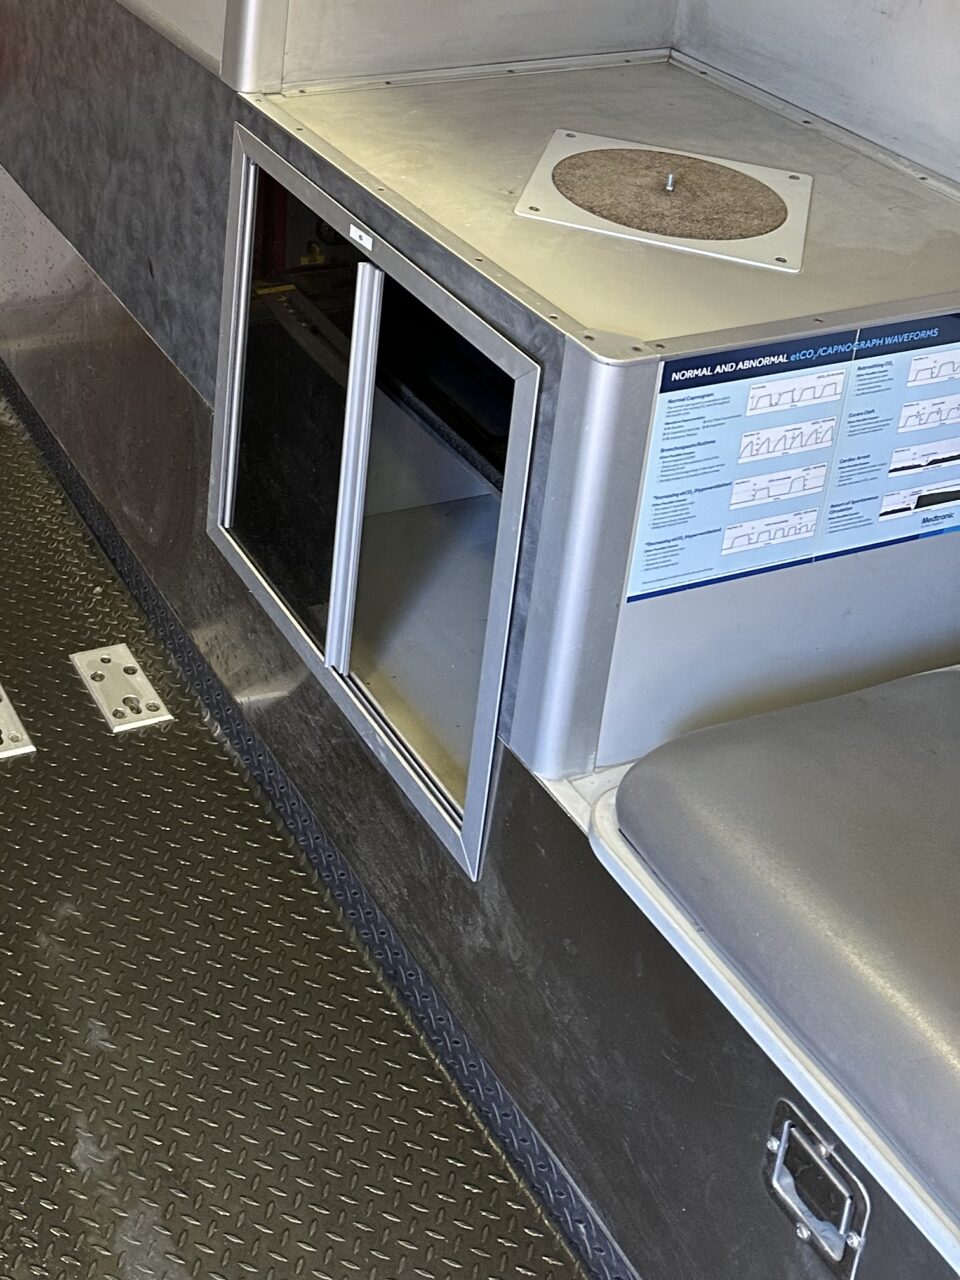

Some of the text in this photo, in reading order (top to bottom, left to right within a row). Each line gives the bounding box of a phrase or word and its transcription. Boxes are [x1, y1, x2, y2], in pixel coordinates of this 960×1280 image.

[671, 366, 713, 382] NORMAL
[714, 362, 736, 375] AND
[736, 353, 789, 371] ABNORMAL
[884, 327, 939, 344] WAVEFORMS
[921, 511, 955, 524] Medtronic
